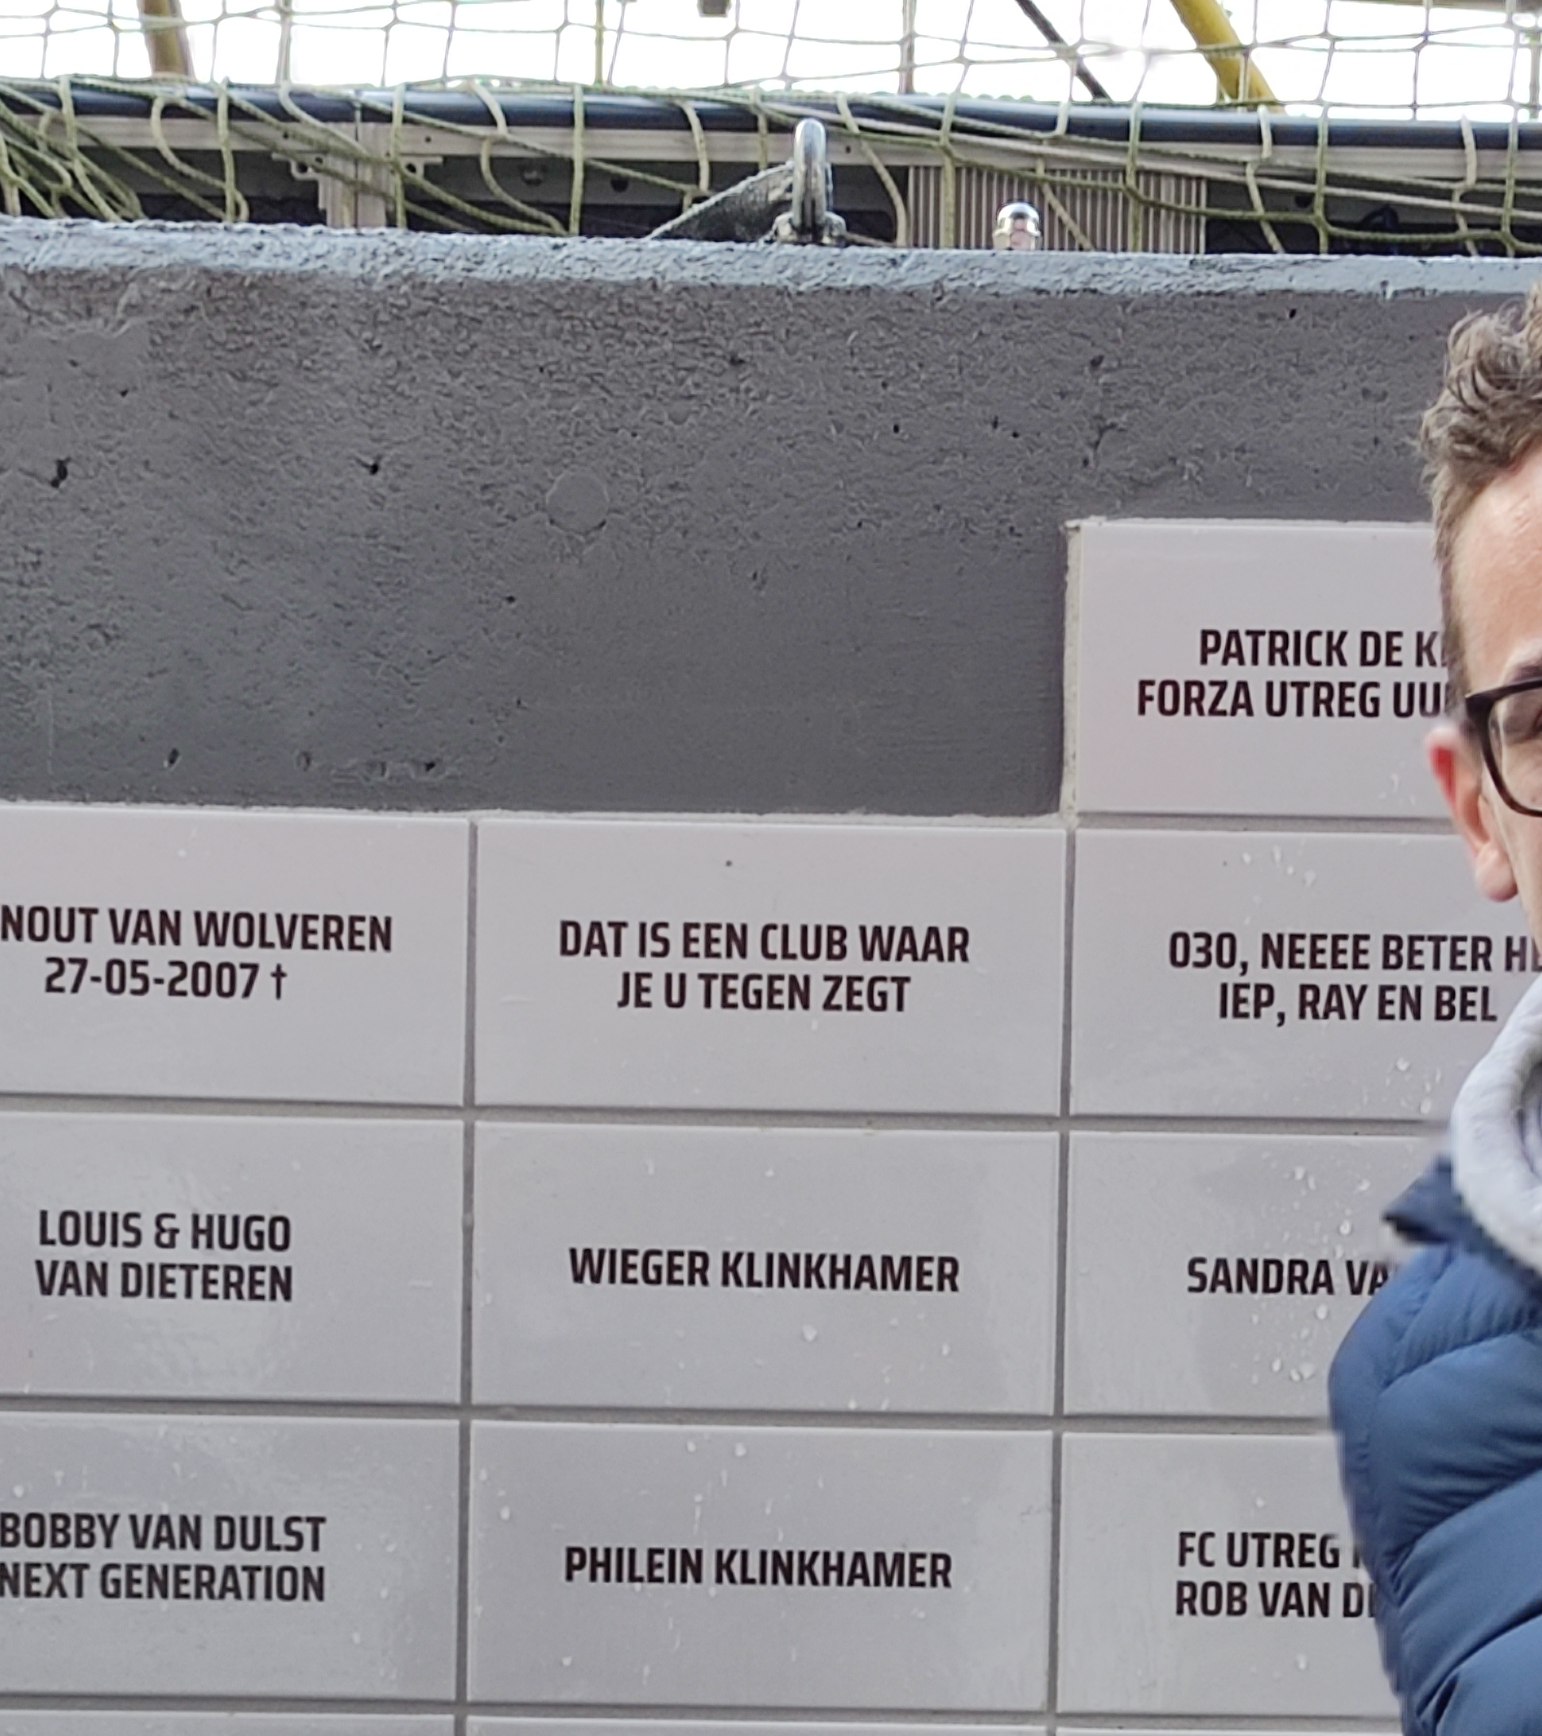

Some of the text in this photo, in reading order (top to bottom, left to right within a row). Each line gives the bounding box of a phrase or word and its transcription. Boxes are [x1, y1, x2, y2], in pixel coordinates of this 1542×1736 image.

[1200, 629, 1403, 667] PATRICK DE
[1138, 680, 1380, 718] FORZA UTREG
[108, 908, 181, 946] VAN
[194, 911, 392, 952] WOLVEREN
[560, 920, 969, 962] DAT IS EEN CLUB WAAR
[1261, 933, 1370, 970] NEEEE
[1382, 934, 1492, 972] BETER
[45, 957, 259, 999] 27-05-2007
[1220, 982, 1497, 1027] IEP, RAY EN BEL
[40, 1210, 290, 1252] LOUIS & HUGO
[35, 1260, 292, 1302] VAN DIETEREN
[569, 1247, 959, 1292] WIEGER KLINKHAMER
[1188, 1257, 1335, 1295] SANDRA
[0, 1512, 326, 1552] BOBBY VAN DULST
[1179, 1532, 1215, 1567] FC
[1227, 1532, 1340, 1569] UTREG
[100, 1563, 324, 1602] GENERATION
[565, 1546, 951, 1588] PHILEIN KLINKHAMER
